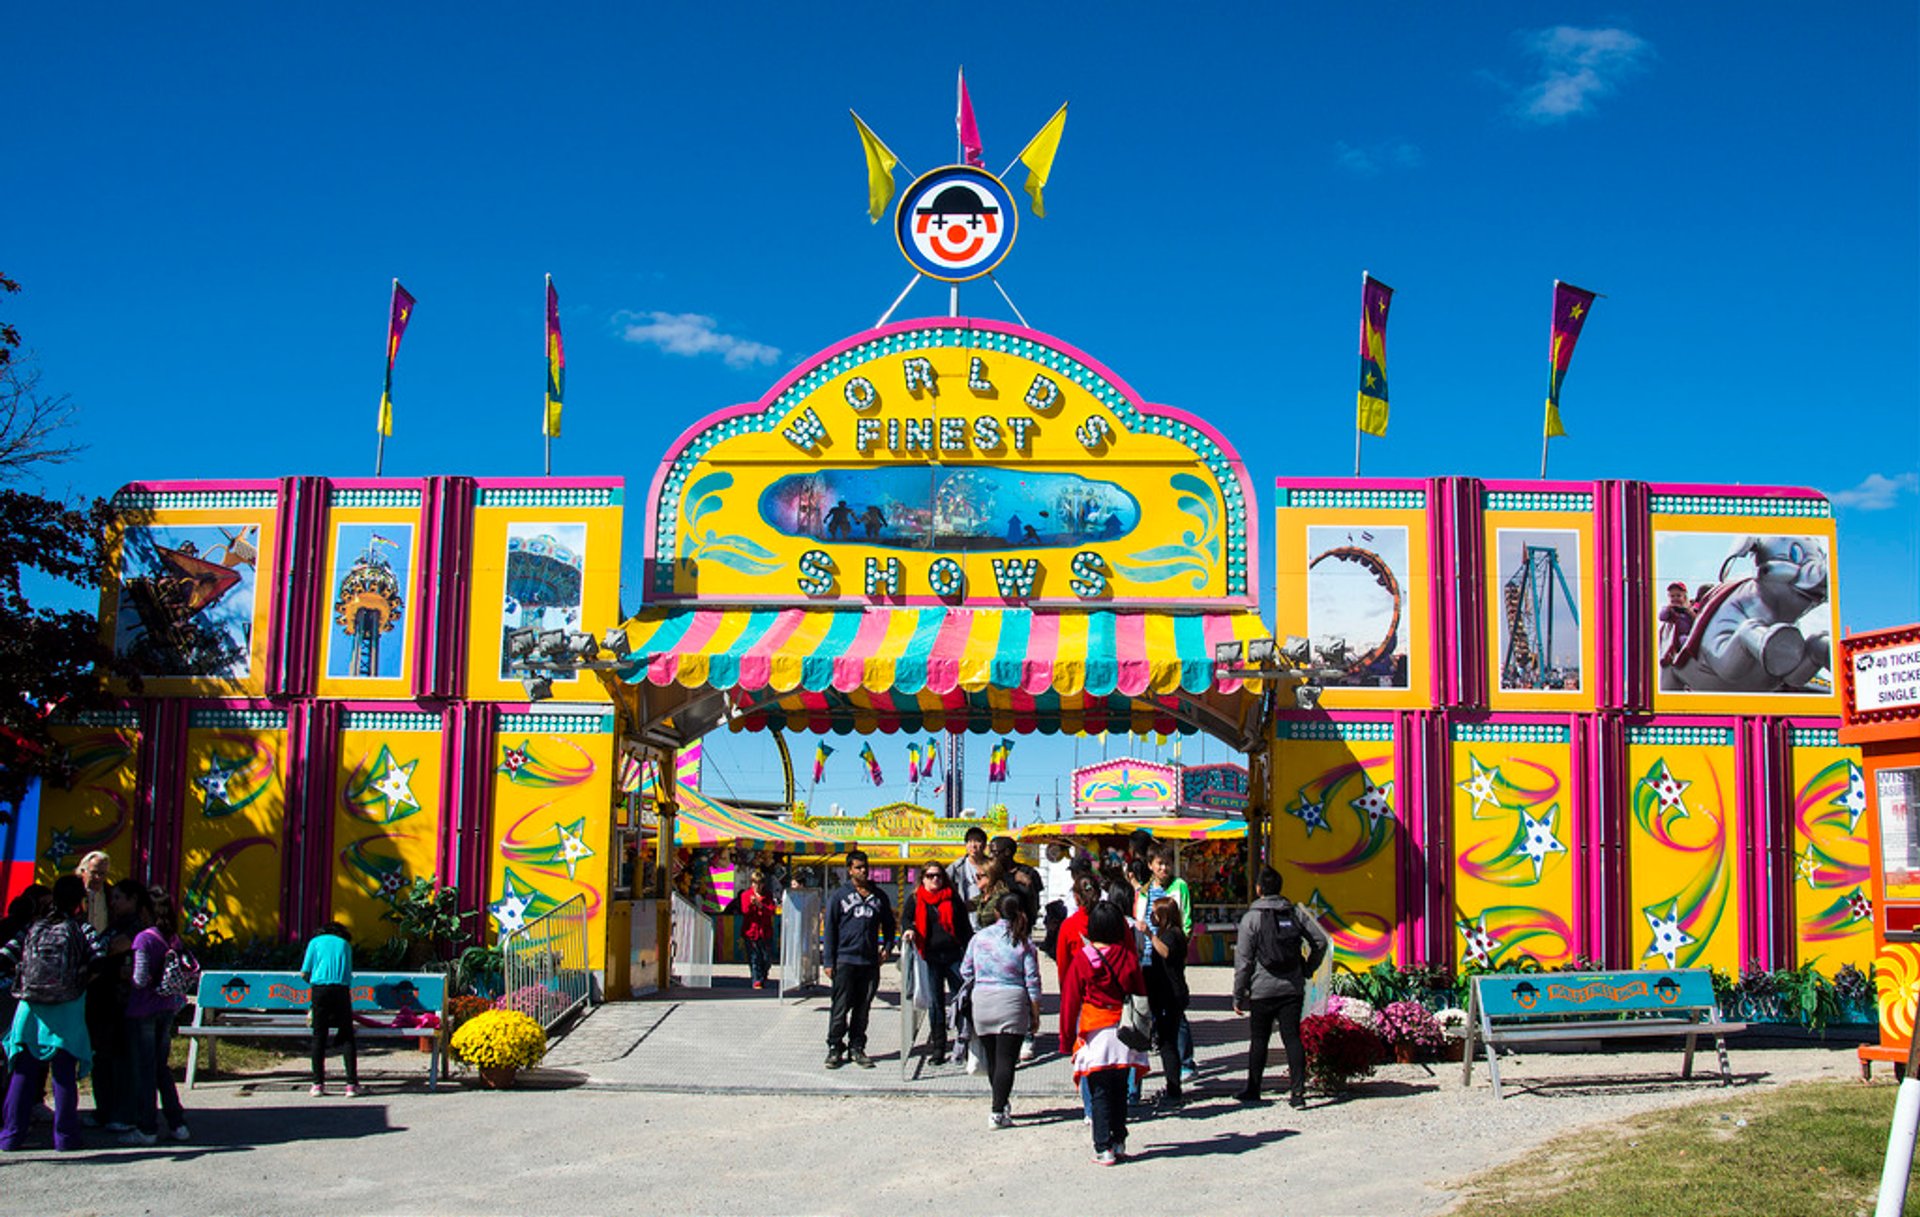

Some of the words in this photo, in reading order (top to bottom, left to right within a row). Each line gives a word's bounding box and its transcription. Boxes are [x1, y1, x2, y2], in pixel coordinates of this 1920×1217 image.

[783, 356, 1110, 450] WORLDS
[856, 416, 1034, 451] FINEST
[797, 549, 1107, 598] SHOWS
[1876, 656, 1888, 668] 40
[1878, 673, 1889, 686] 18
[1878, 686, 1918, 703] SINGLE
